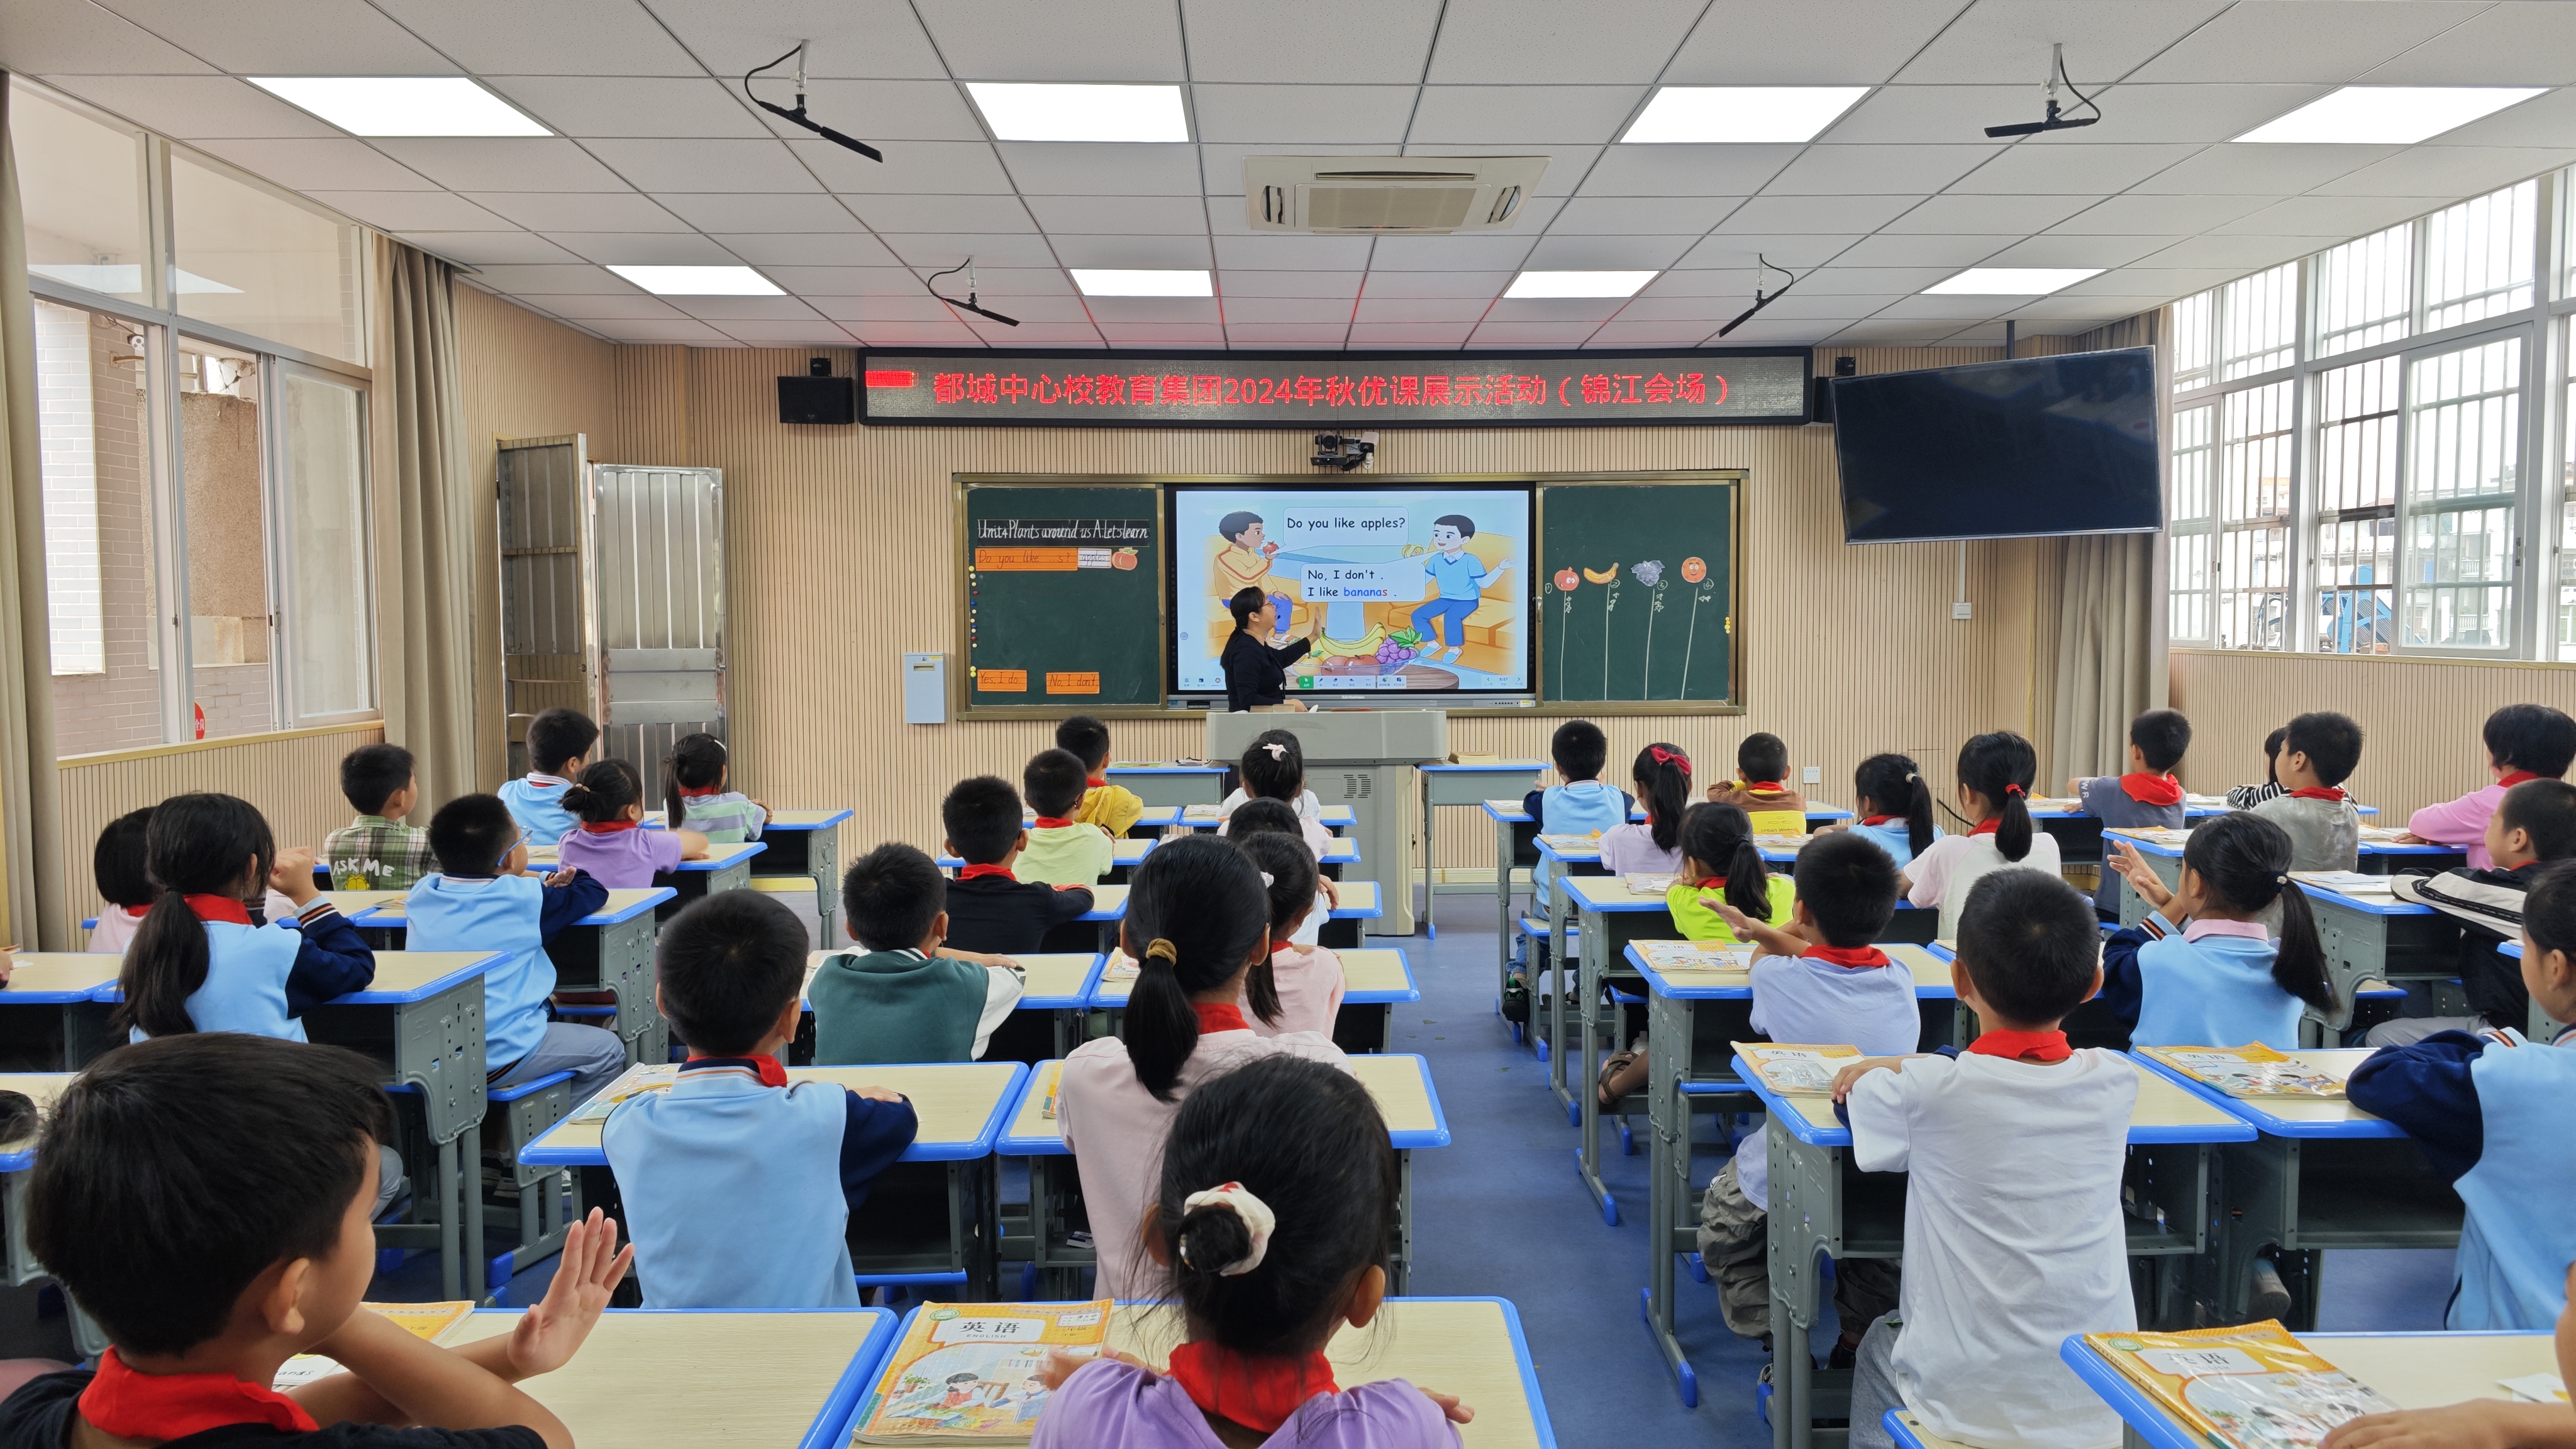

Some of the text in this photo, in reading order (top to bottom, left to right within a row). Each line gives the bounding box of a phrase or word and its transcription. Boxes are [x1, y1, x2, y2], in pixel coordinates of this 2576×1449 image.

[1009, 519, 1039, 539] Plants
[1041, 519, 1079, 539] around
[1080, 527, 1092, 538] us
[1287, 517, 1406, 531] Do you like apples?
[979, 550, 992, 563] Do
[999, 555, 1014, 569] you
[1023, 550, 1039, 562] like
[1081, 550, 1106, 566] apples
[1308, 570, 1327, 581] No,
[1333, 570, 1340, 579] I
[1308, 587, 1314, 596] I
[1319, 586, 1338, 596] like
[1344, 587, 1387, 597] bananas
[980, 672, 996, 685] Yes,
[999, 672, 1003, 684] I
[1049, 674, 1063, 687] No,
[1067, 674, 1071, 686] I
[333, 857, 395, 877] ASK ME
[960, 1321, 1020, 1333] 英语
